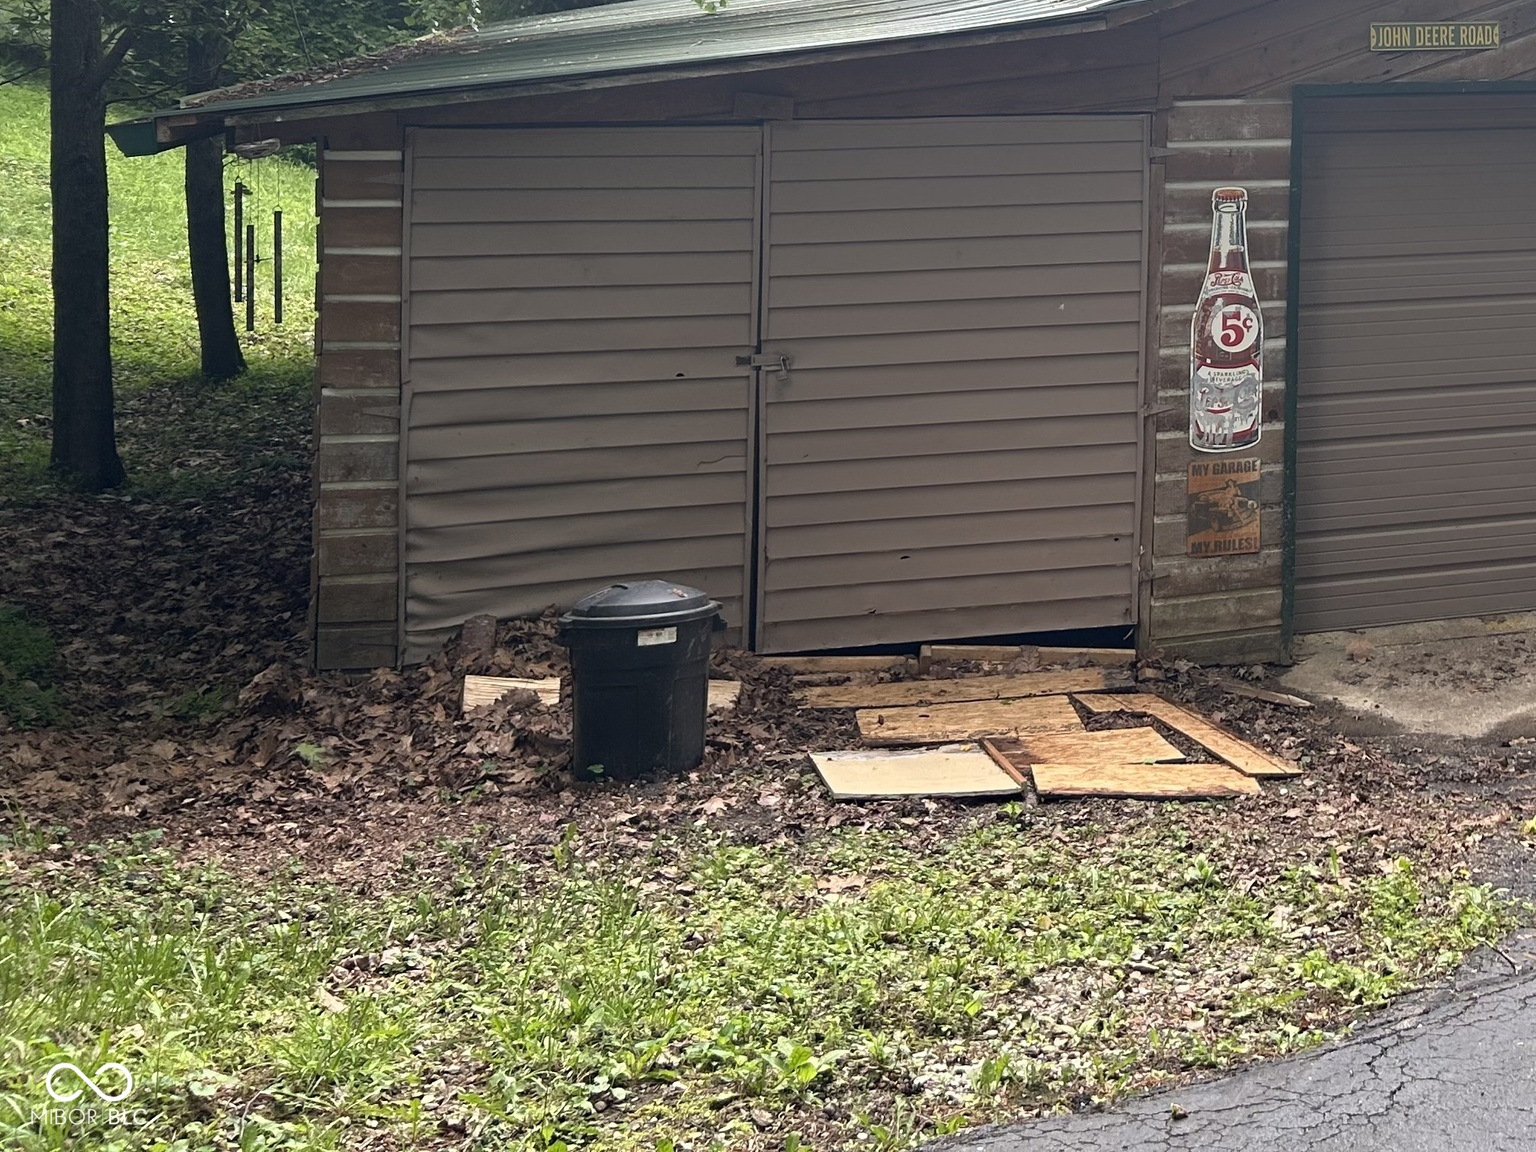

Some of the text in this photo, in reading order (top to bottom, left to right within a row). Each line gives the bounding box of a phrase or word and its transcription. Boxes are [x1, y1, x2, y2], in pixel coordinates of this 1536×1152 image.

[1378, 25, 1492, 47] JOHN DEERE ROAD
[1212, 375, 1243, 383] BEVERAGE
[1213, 369, 1250, 378] SPARKLING
[1191, 460, 1258, 477] MY GARAGE
[1191, 537, 1258, 554] MY RULES!
